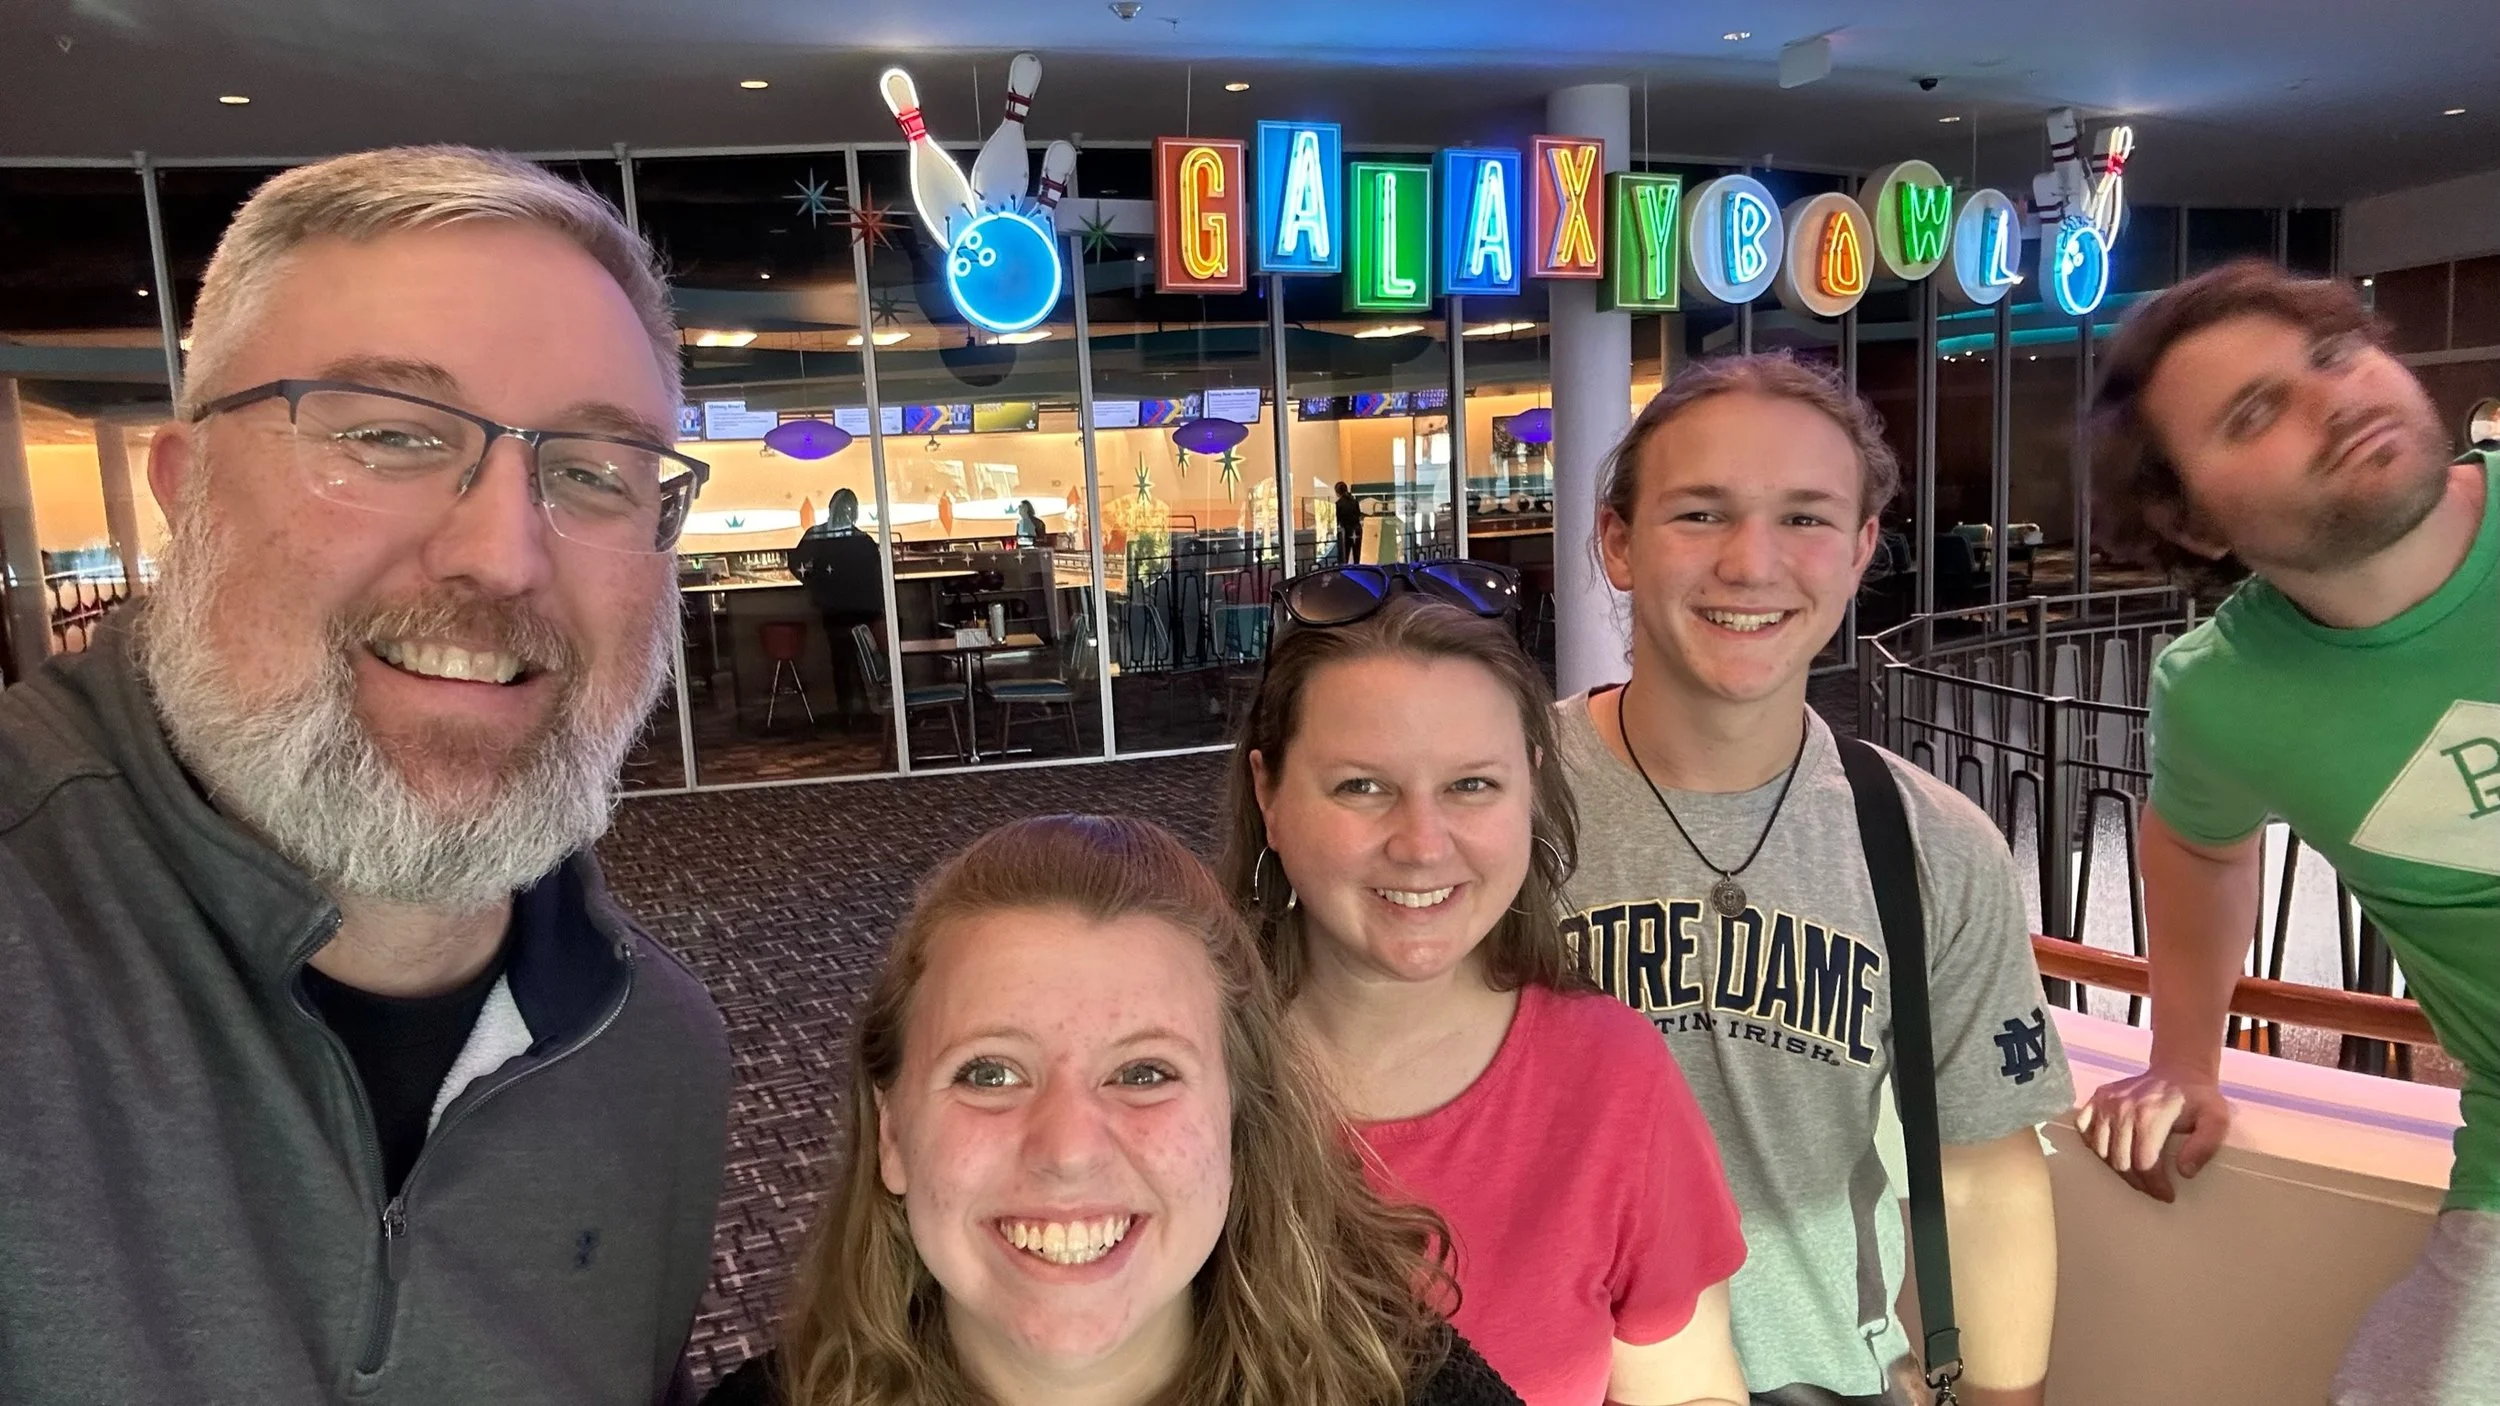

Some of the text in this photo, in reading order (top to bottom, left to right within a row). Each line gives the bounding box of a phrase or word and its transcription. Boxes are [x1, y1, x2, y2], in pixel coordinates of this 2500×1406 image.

[1179, 131, 2024, 299] GALAXY BOWL
[1559, 899, 1883, 1068] OTRE DAME
[1653, 1012, 1717, 1035] TIN'
